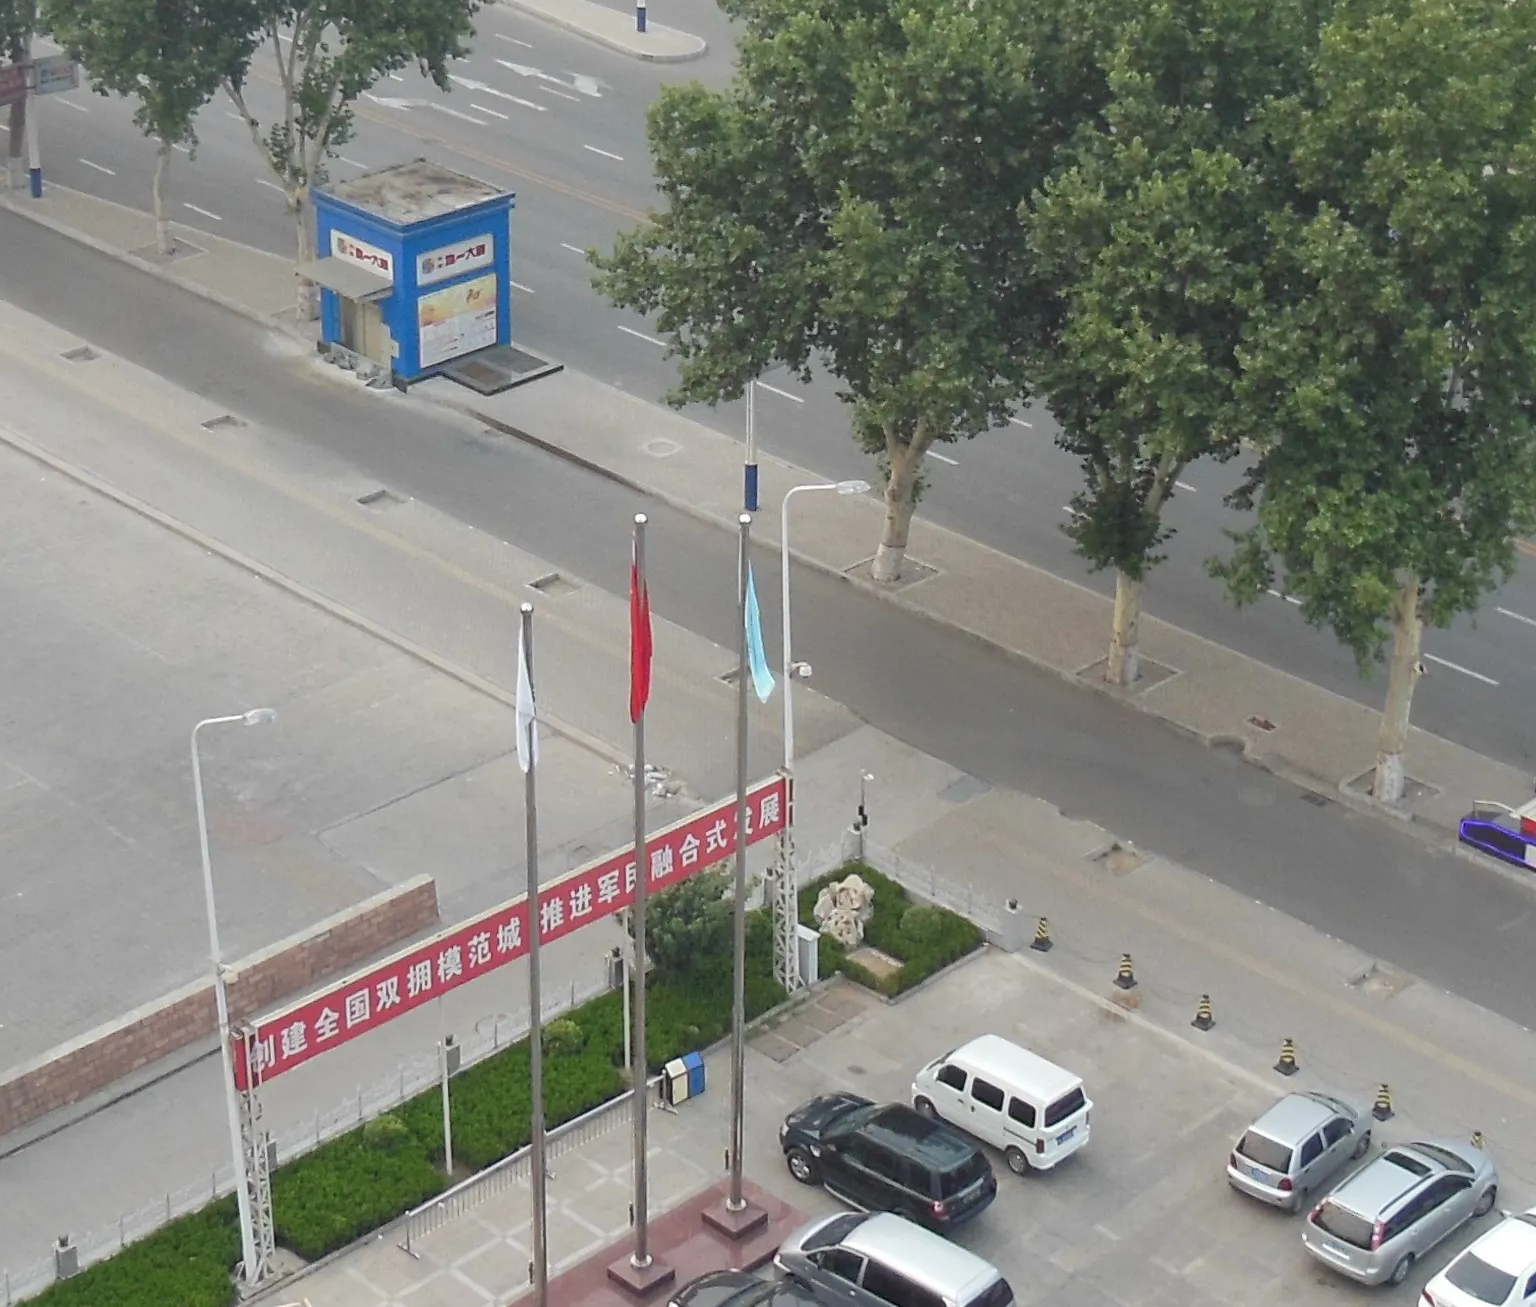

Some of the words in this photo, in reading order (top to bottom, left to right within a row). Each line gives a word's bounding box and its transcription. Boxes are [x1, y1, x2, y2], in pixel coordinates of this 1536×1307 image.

[250, 916, 522, 1073] 创建全国双拥模范城
